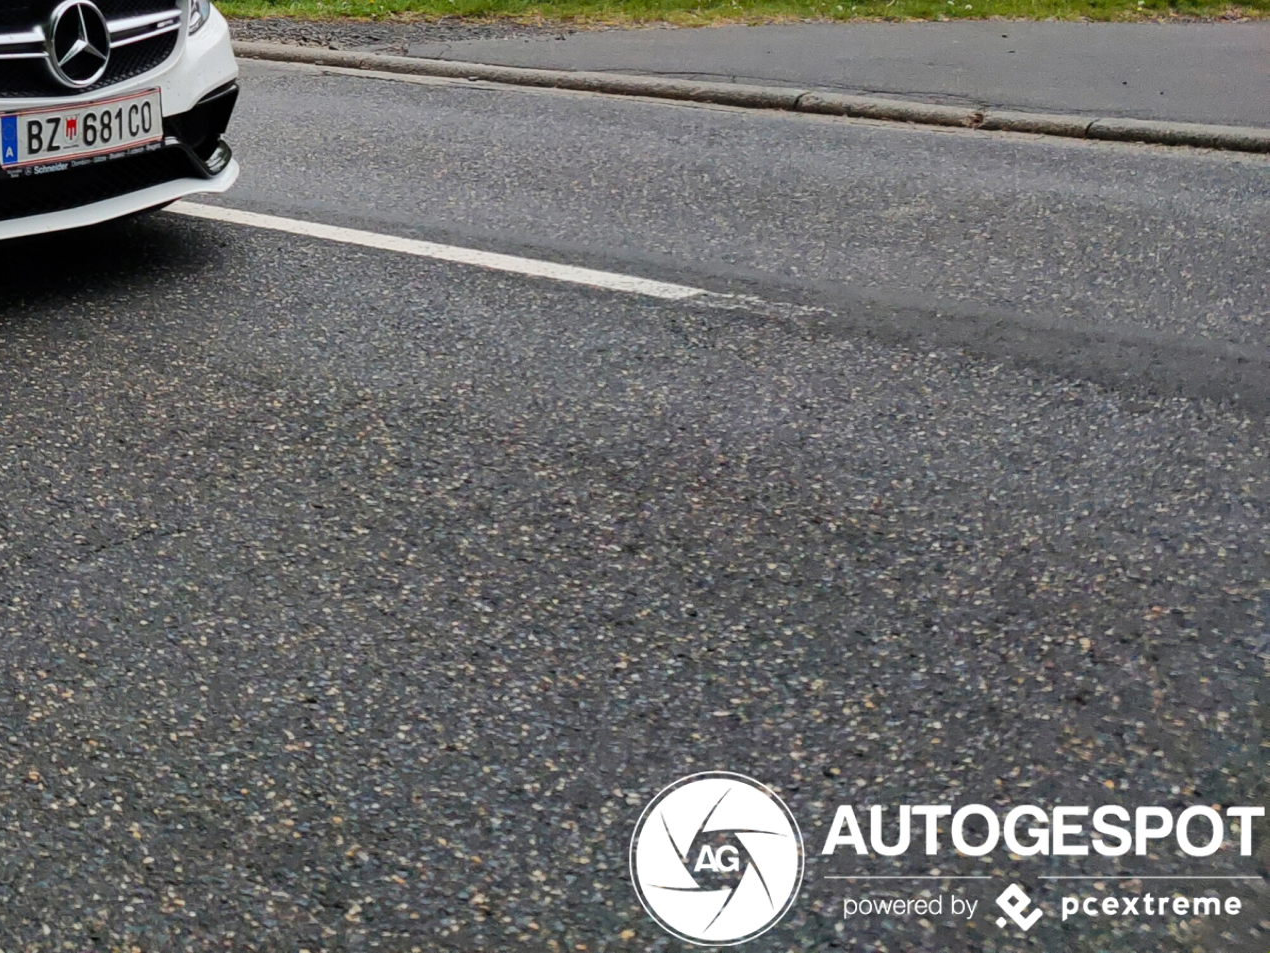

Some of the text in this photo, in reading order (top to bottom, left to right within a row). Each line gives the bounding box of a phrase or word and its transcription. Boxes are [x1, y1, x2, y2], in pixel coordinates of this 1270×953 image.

[27, 117, 61, 155] BZ
[5, 146, 15, 158] A
[33, 162, 69, 175] Schneider
